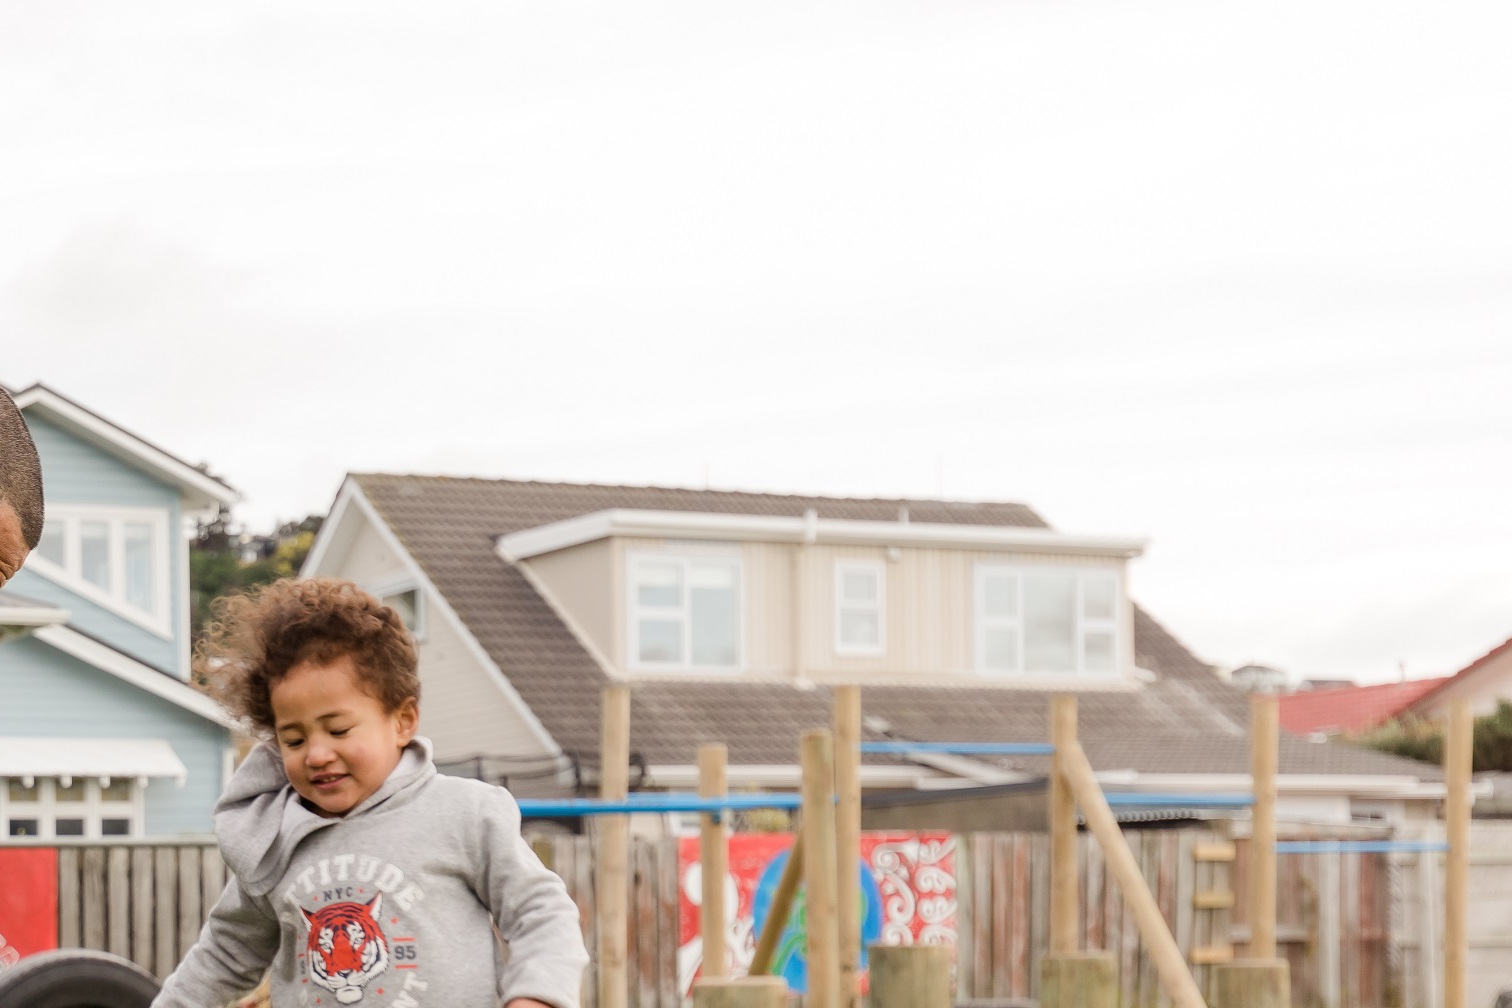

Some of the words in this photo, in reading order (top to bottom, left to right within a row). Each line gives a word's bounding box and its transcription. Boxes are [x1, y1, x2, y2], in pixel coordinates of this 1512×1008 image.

[281, 853, 426, 914] TTITUDE
[323, 886, 355, 902] NYC
[394, 945, 417, 960] 95
